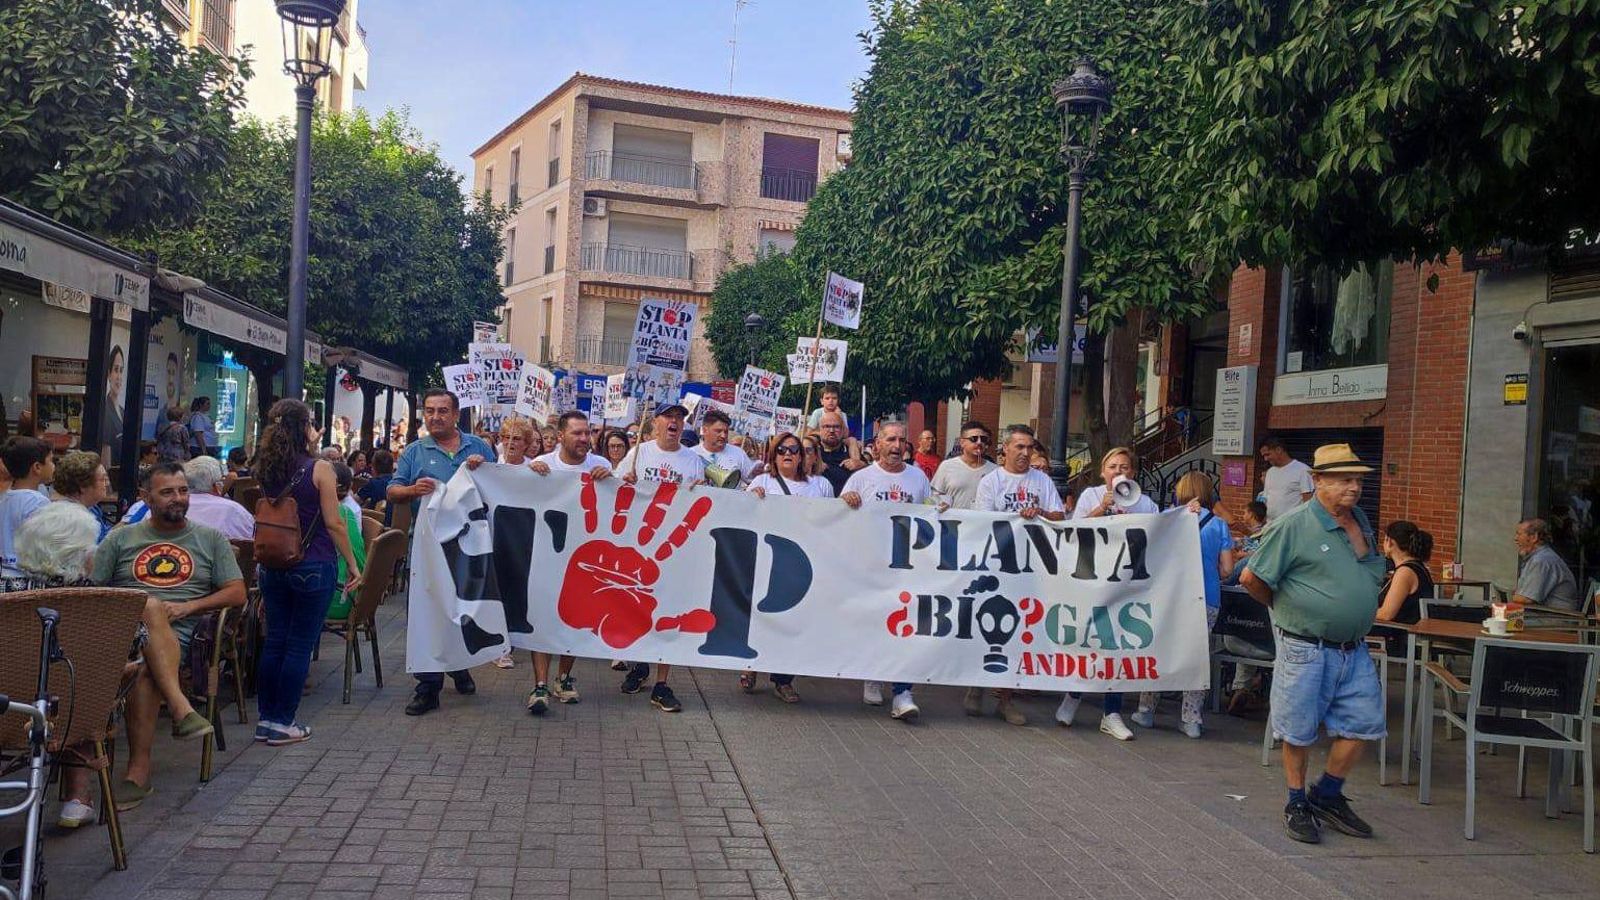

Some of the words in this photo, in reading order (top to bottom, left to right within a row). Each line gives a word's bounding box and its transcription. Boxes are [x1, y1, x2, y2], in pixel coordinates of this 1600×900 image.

[641, 303, 692, 328] STOP
[638, 321, 688, 341] PLANTA
[484, 355, 524, 371] STOP
[746, 371, 780, 391] STOP
[645, 465, 678, 480] STOP
[876, 489, 909, 502] STOP
[1004, 491, 1035, 503] STOP
[888, 514, 1151, 583] PLANTA
[137, 545, 190, 576] BULTACO
[1016, 651, 1159, 681] ANDÚJAR
[1500, 680, 1560, 697] Schweppes
